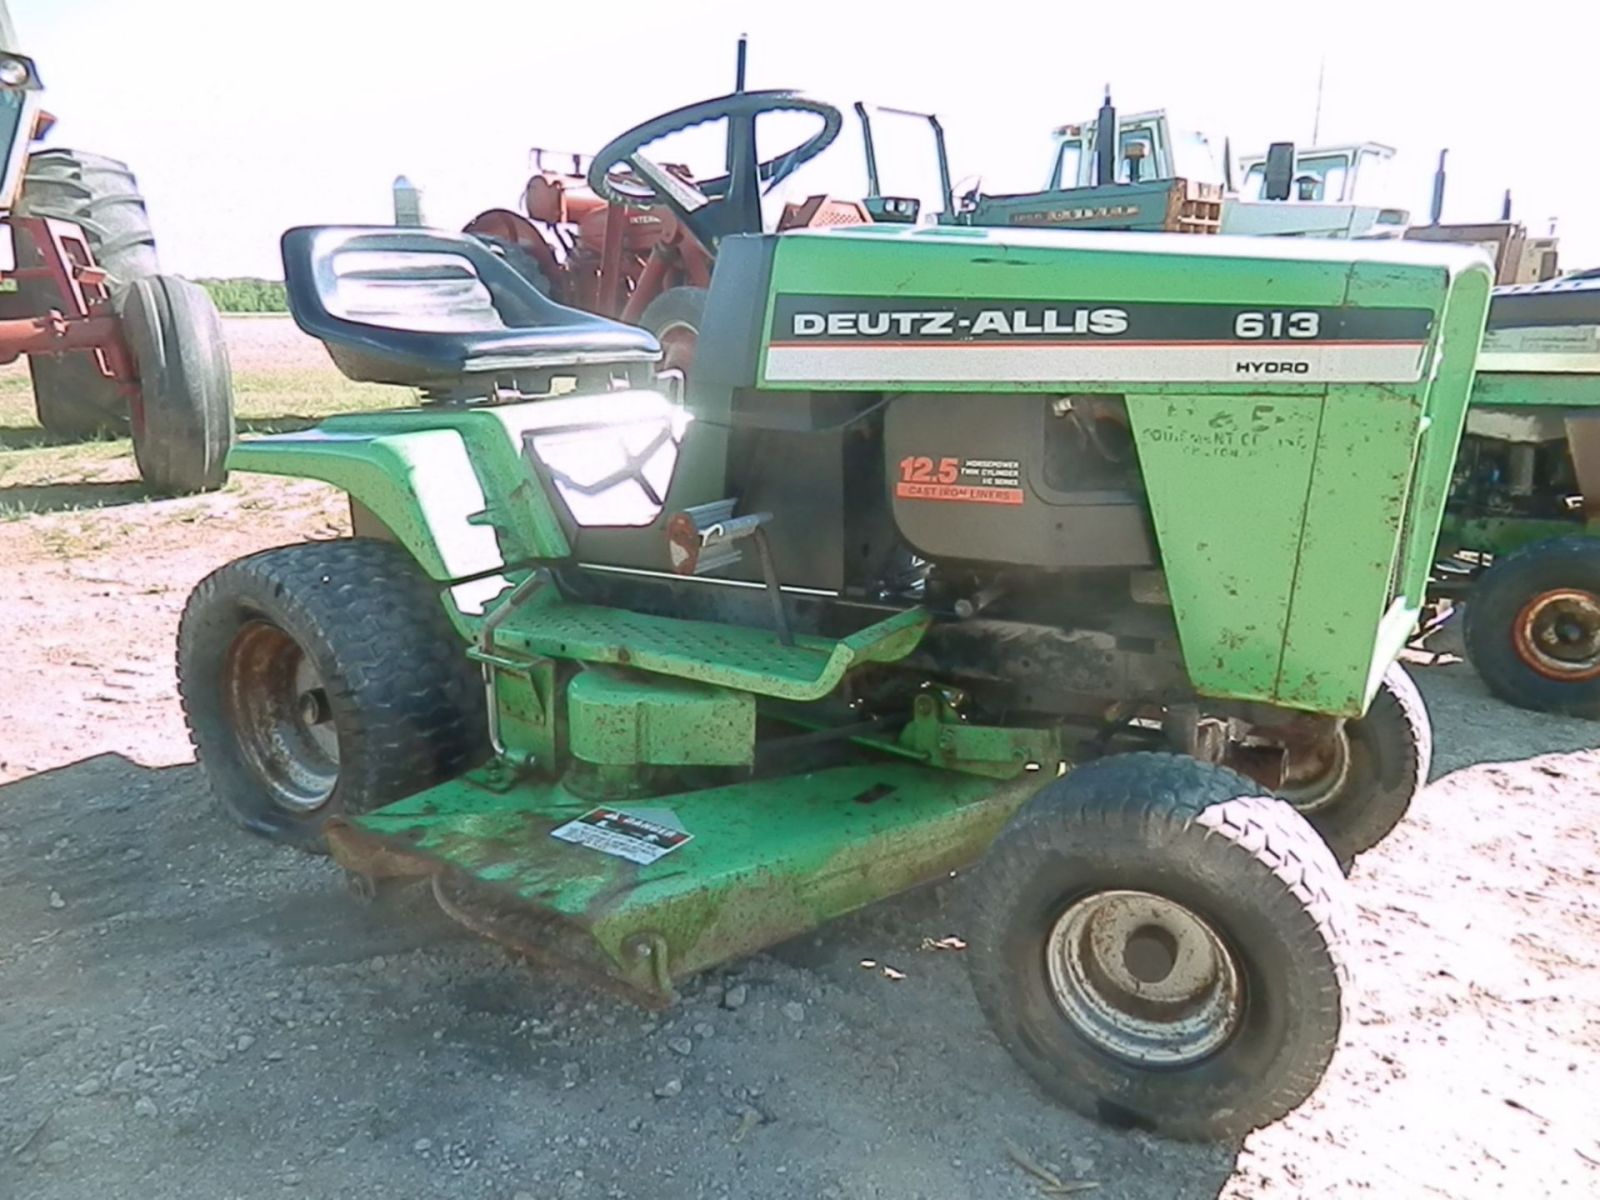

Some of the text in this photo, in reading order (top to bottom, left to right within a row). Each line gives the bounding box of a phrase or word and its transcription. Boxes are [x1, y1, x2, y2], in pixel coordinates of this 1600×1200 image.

[793, 308, 1129, 337] DEUTZ-ALLIS
[1234, 312, 1321, 339] 613
[1236, 361, 1309, 375] HYDRO
[900, 456, 959, 483] 12.5
[908, 486, 1010, 500] CAST IRON LINERS
